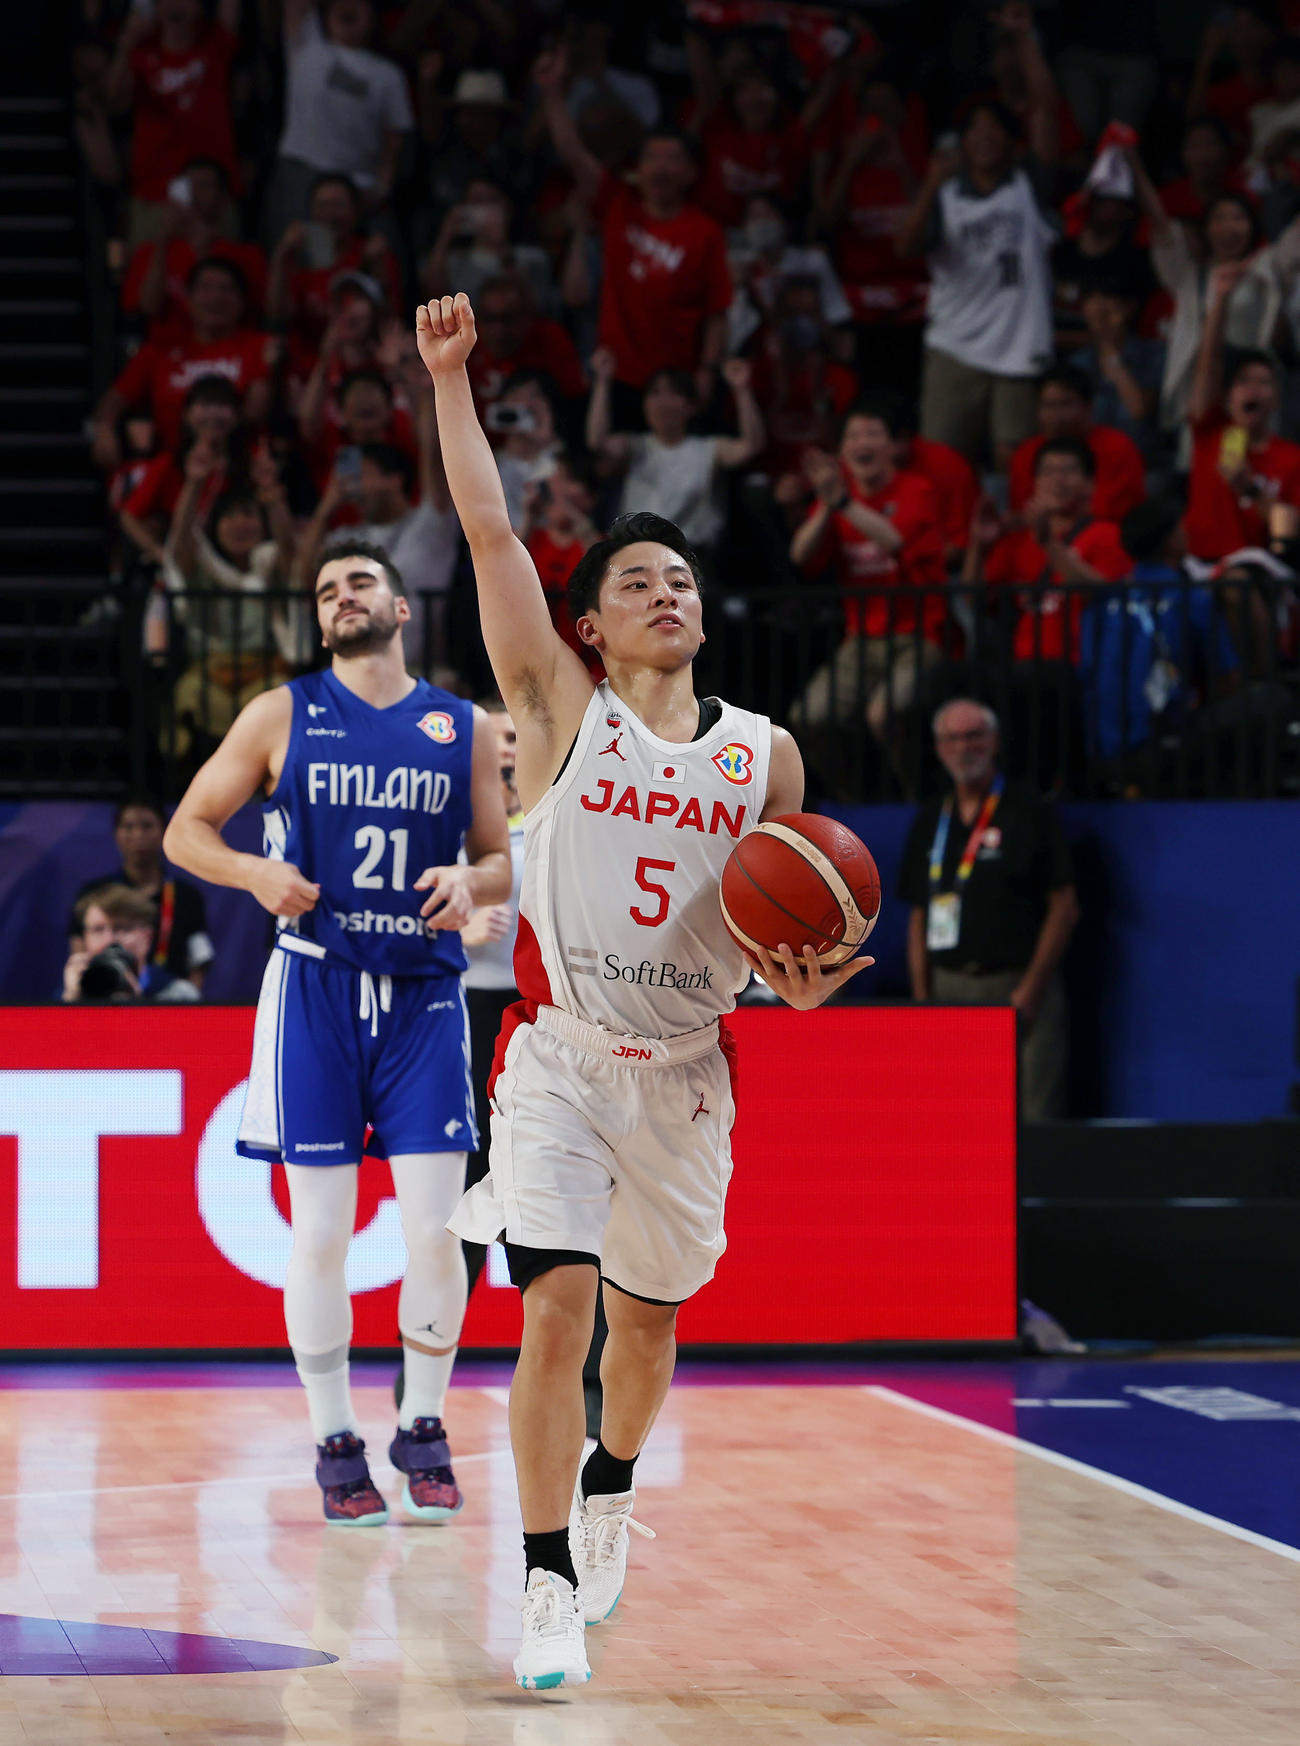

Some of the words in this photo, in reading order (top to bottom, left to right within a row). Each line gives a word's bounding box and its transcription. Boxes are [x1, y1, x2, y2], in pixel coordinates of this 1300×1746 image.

[308, 762, 450, 814] FINLAND
[580, 778, 747, 839] JAPAN
[352, 825, 408, 891] 21
[629, 856, 676, 927] 5
[603, 954, 714, 990] SoftBank
[611, 1045, 653, 1061] JPN
